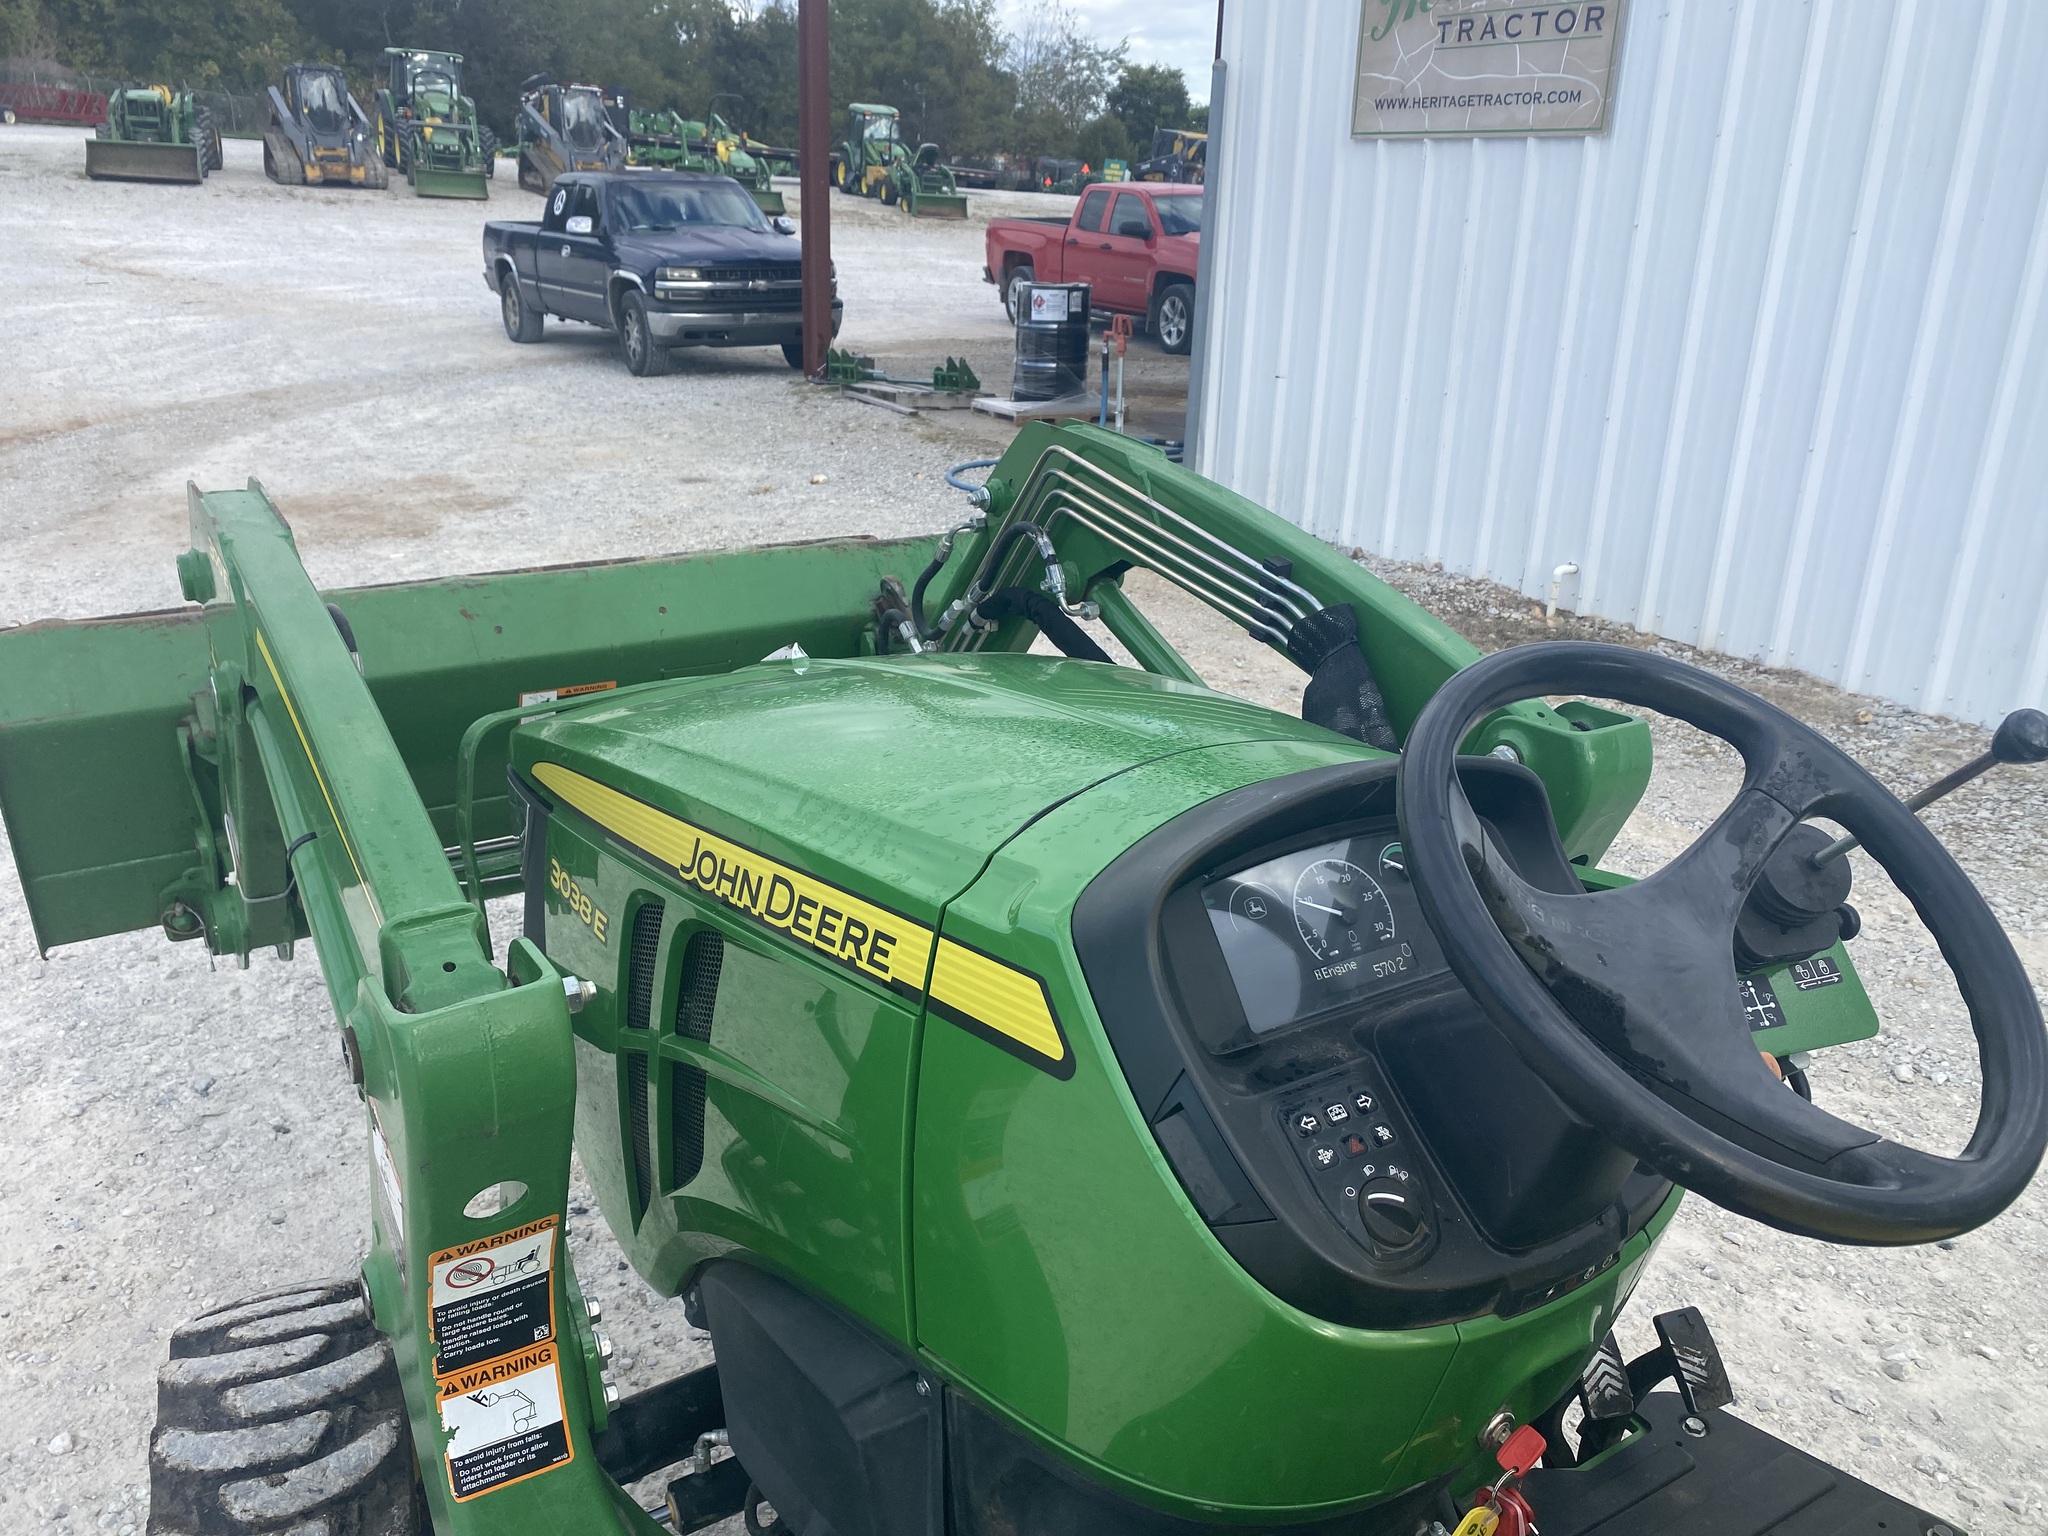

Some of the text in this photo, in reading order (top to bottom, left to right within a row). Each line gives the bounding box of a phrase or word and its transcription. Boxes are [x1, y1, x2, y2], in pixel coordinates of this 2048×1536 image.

[1437, 6, 1605, 44] TRACTOR
[1374, 90, 1581, 110] WWW.HERITAGETRACTOR.COM
[573, 684, 608, 693] WARNING
[1315, 875, 1324, 885] 15
[1341, 873, 1351, 883] 20
[679, 837, 898, 976] JOHN DEERE
[1304, 896, 1313, 904] 10
[1362, 891, 1373, 902] 25
[1312, 929, 1318, 938] 5
[1373, 922, 1384, 932] 30
[1321, 939, 1328, 948] 0
[456, 1219, 552, 1256] WARNING
[447, 1303, 468, 1314] avoid
[469, 1297, 490, 1307] injury
[501, 1287, 521, 1298] death
[521, 1277, 547, 1290] caused
[447, 1309, 471, 1320] falling
[453, 1320, 466, 1328] not
[467, 1313, 492, 1324] handle
[493, 1304, 514, 1316] round
[441, 1328, 461, 1338] large
[461, 1320, 487, 1331] square
[442, 1314, 529, 1346] Handle raised loads with
[443, 1339, 472, 1351] caution.
[443, 1337, 501, 1359] Carry loads low.
[460, 1349, 552, 1389] WARNING
[453, 1432, 543, 1468] To avoid injury from falls:
[471, 1464, 484, 1473] not
[484, 1457, 503, 1468] work
[503, 1451, 521, 1460] from
[530, 1441, 549, 1452] allow
[460, 1472, 482, 1485] riders
[493, 1460, 517, 1472] loader
[517, 1456, 526, 1464] or
[526, 1453, 536, 1461] its
[462, 1471, 509, 1492] attachments.
